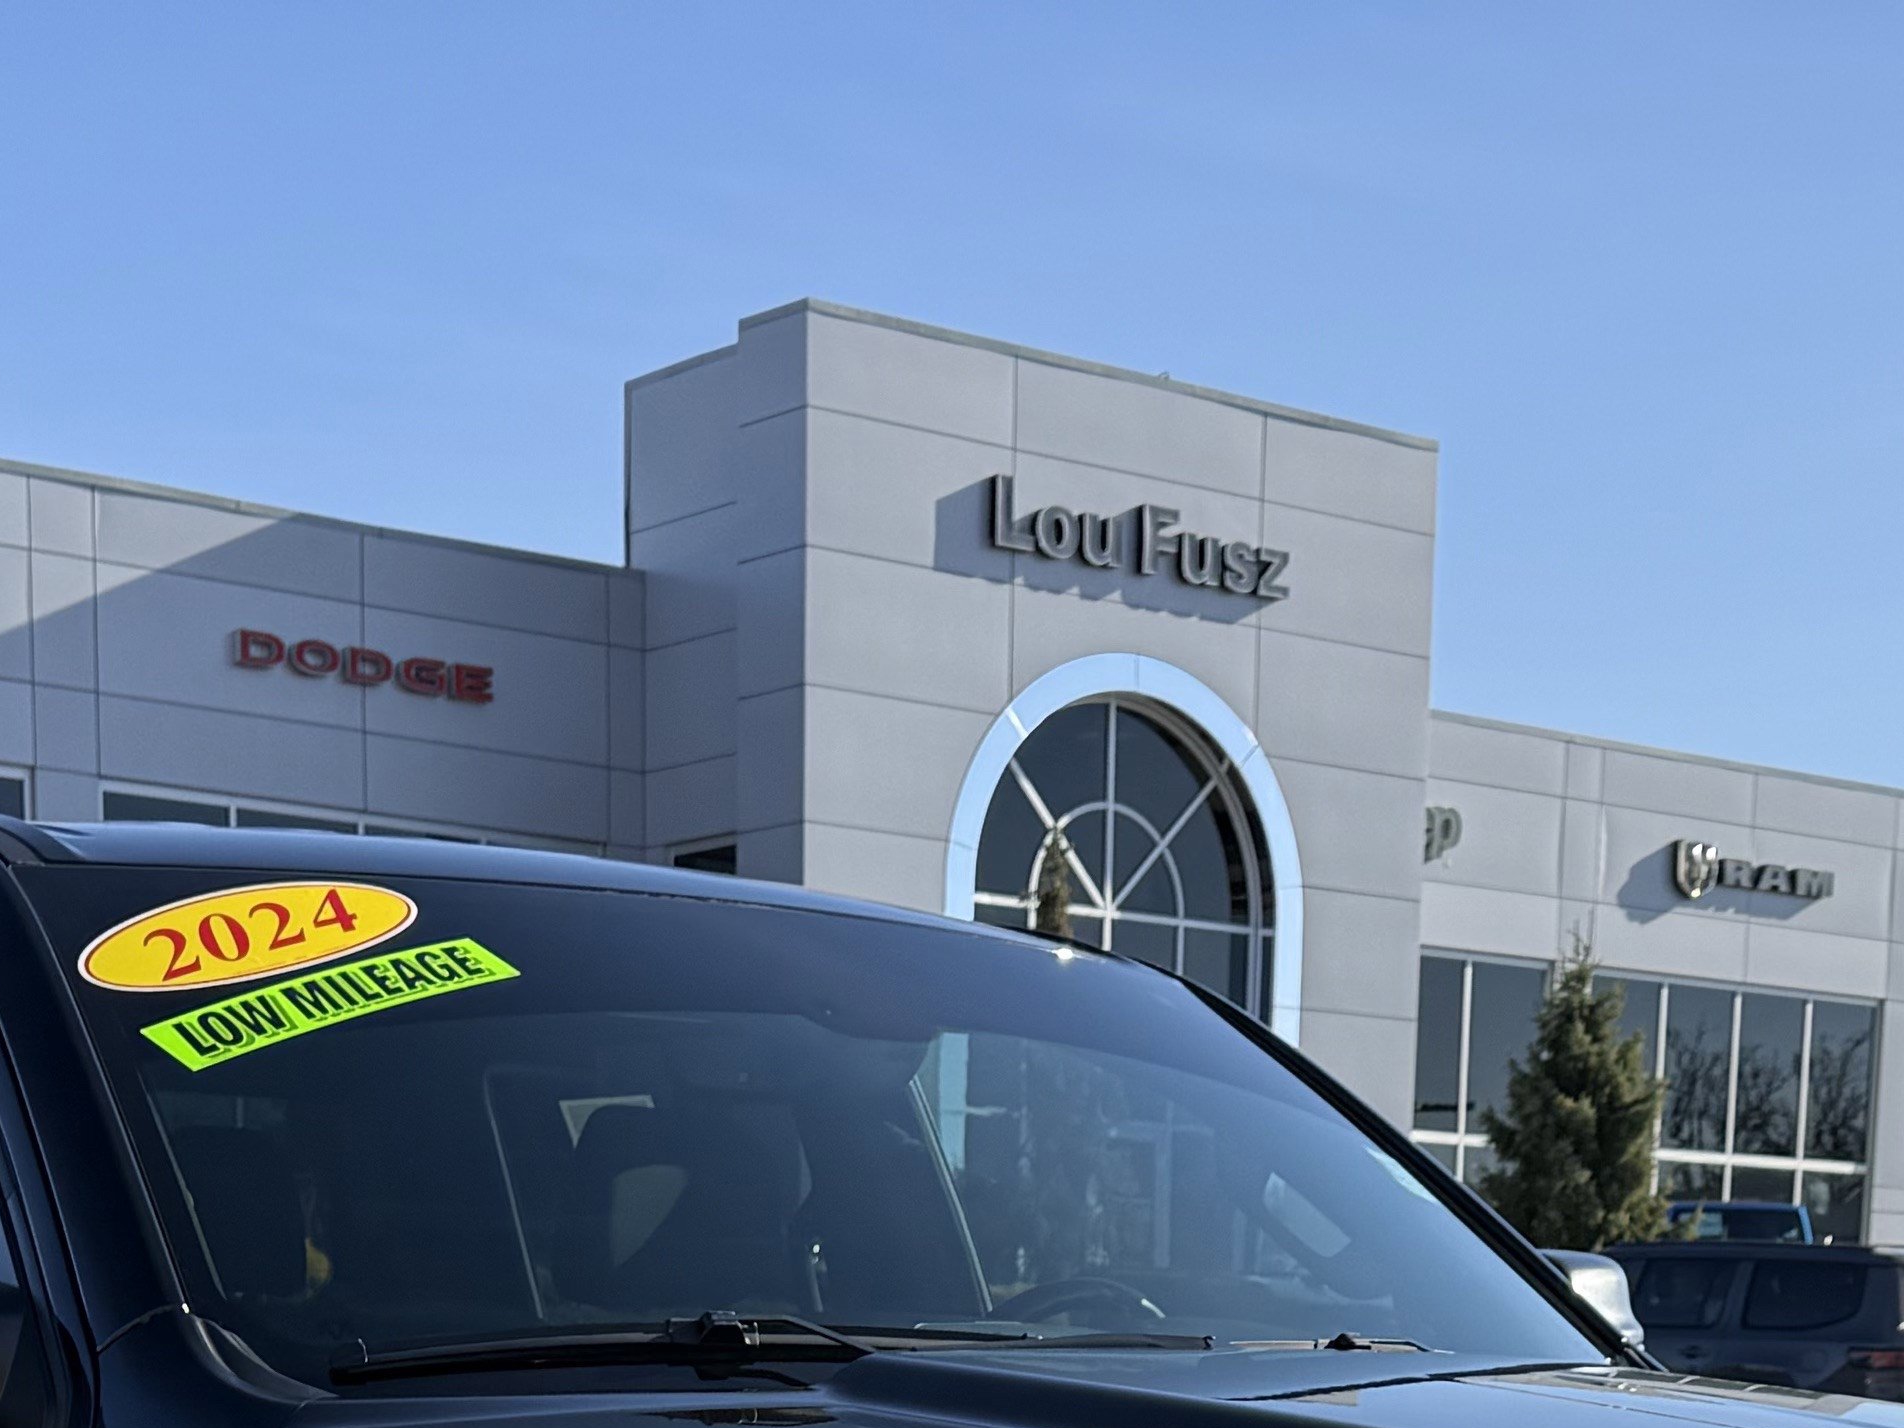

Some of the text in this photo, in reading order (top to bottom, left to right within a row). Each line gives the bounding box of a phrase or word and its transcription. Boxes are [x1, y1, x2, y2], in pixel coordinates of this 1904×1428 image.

[990, 473, 1290, 599] Lou Fusz
[229, 628, 494, 704] DODGE
[1718, 858, 1835, 899] RAM
[142, 888, 357, 981] 2024
[173, 946, 486, 1056] LOW MILEAGE
